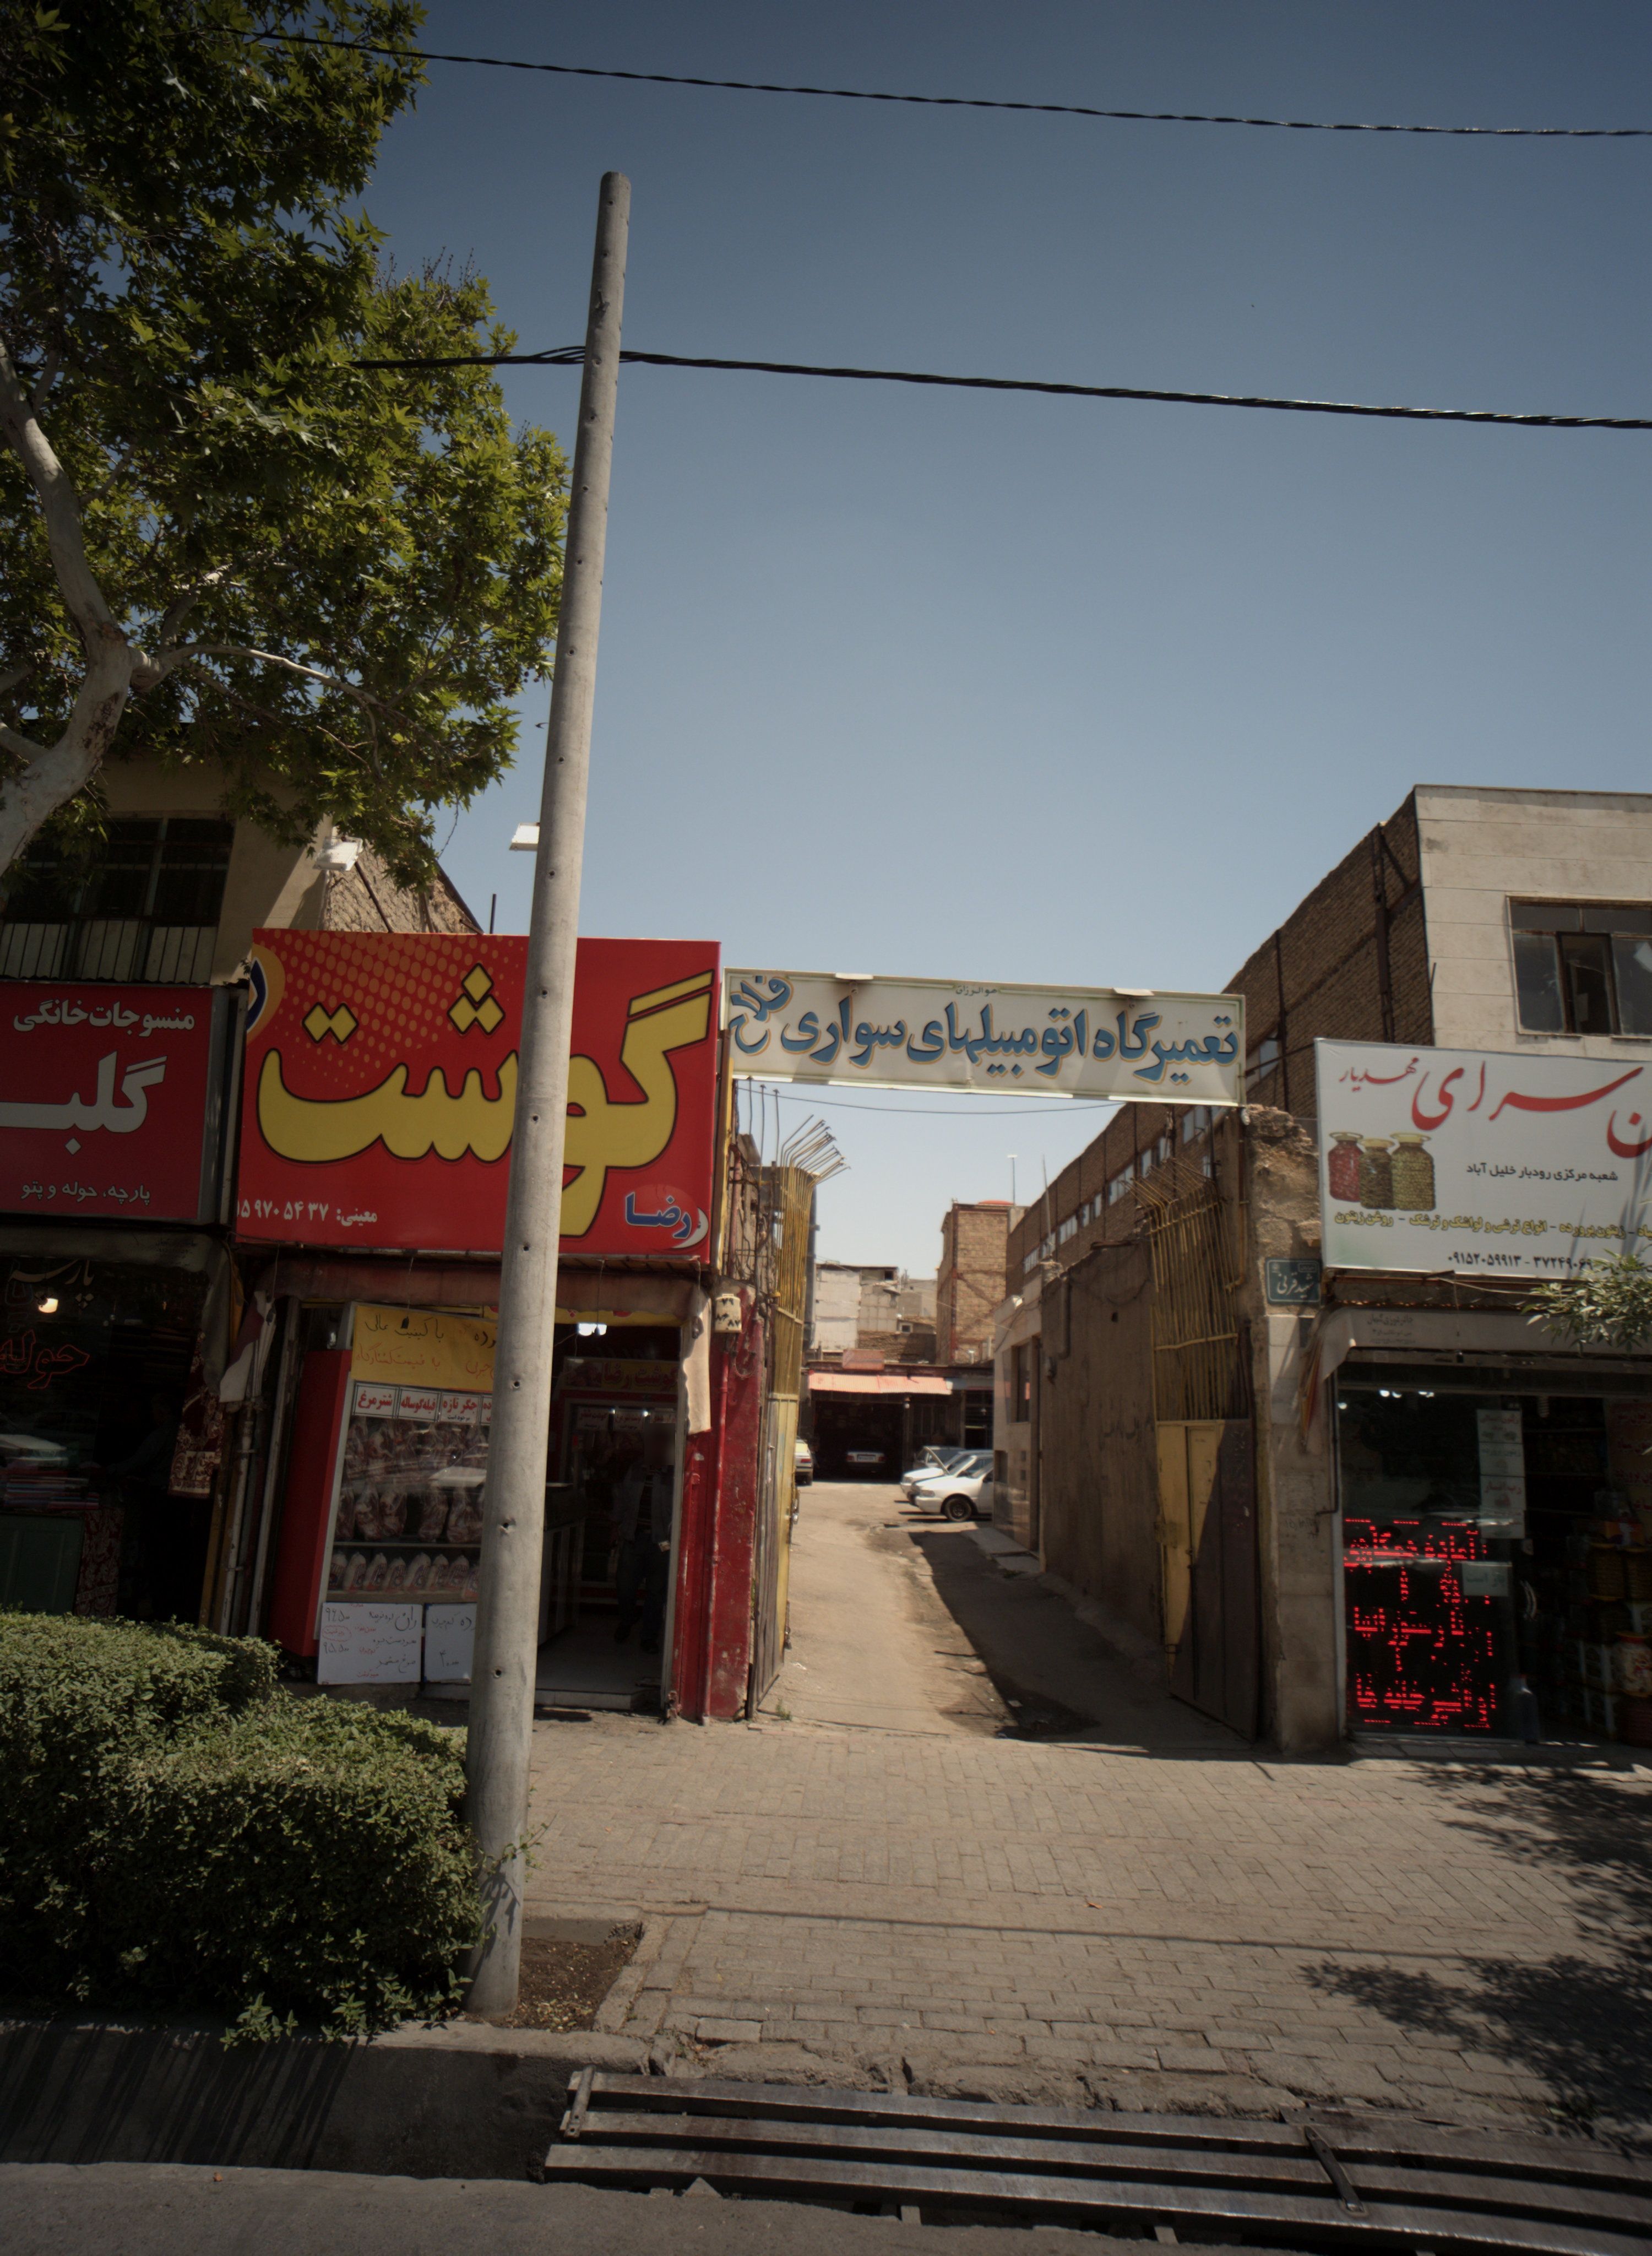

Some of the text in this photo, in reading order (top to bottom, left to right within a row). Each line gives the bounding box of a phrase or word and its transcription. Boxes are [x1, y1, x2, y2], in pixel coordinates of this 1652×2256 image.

[13, 998, 195, 1038] منسوجات خانگی
[780, 994, 907, 1067] سواری
[1093, 1011, 1240, 1086] تعمیرگاه
[1466, 1163, 1618, 1183] شعبه مرکزی رودبار خلیل آباد
[21, 1181, 44, 1200] پتو
[47, 1185, 57, 1199] و
[62, 1181, 98, 1202] حوله
[625, 1191, 692, 1239] رضا
[1365, 1211, 1394, 1227] روغن
[1521, 1220, 1548, 1236] انواع
[435, 1317, 444, 1343] با
